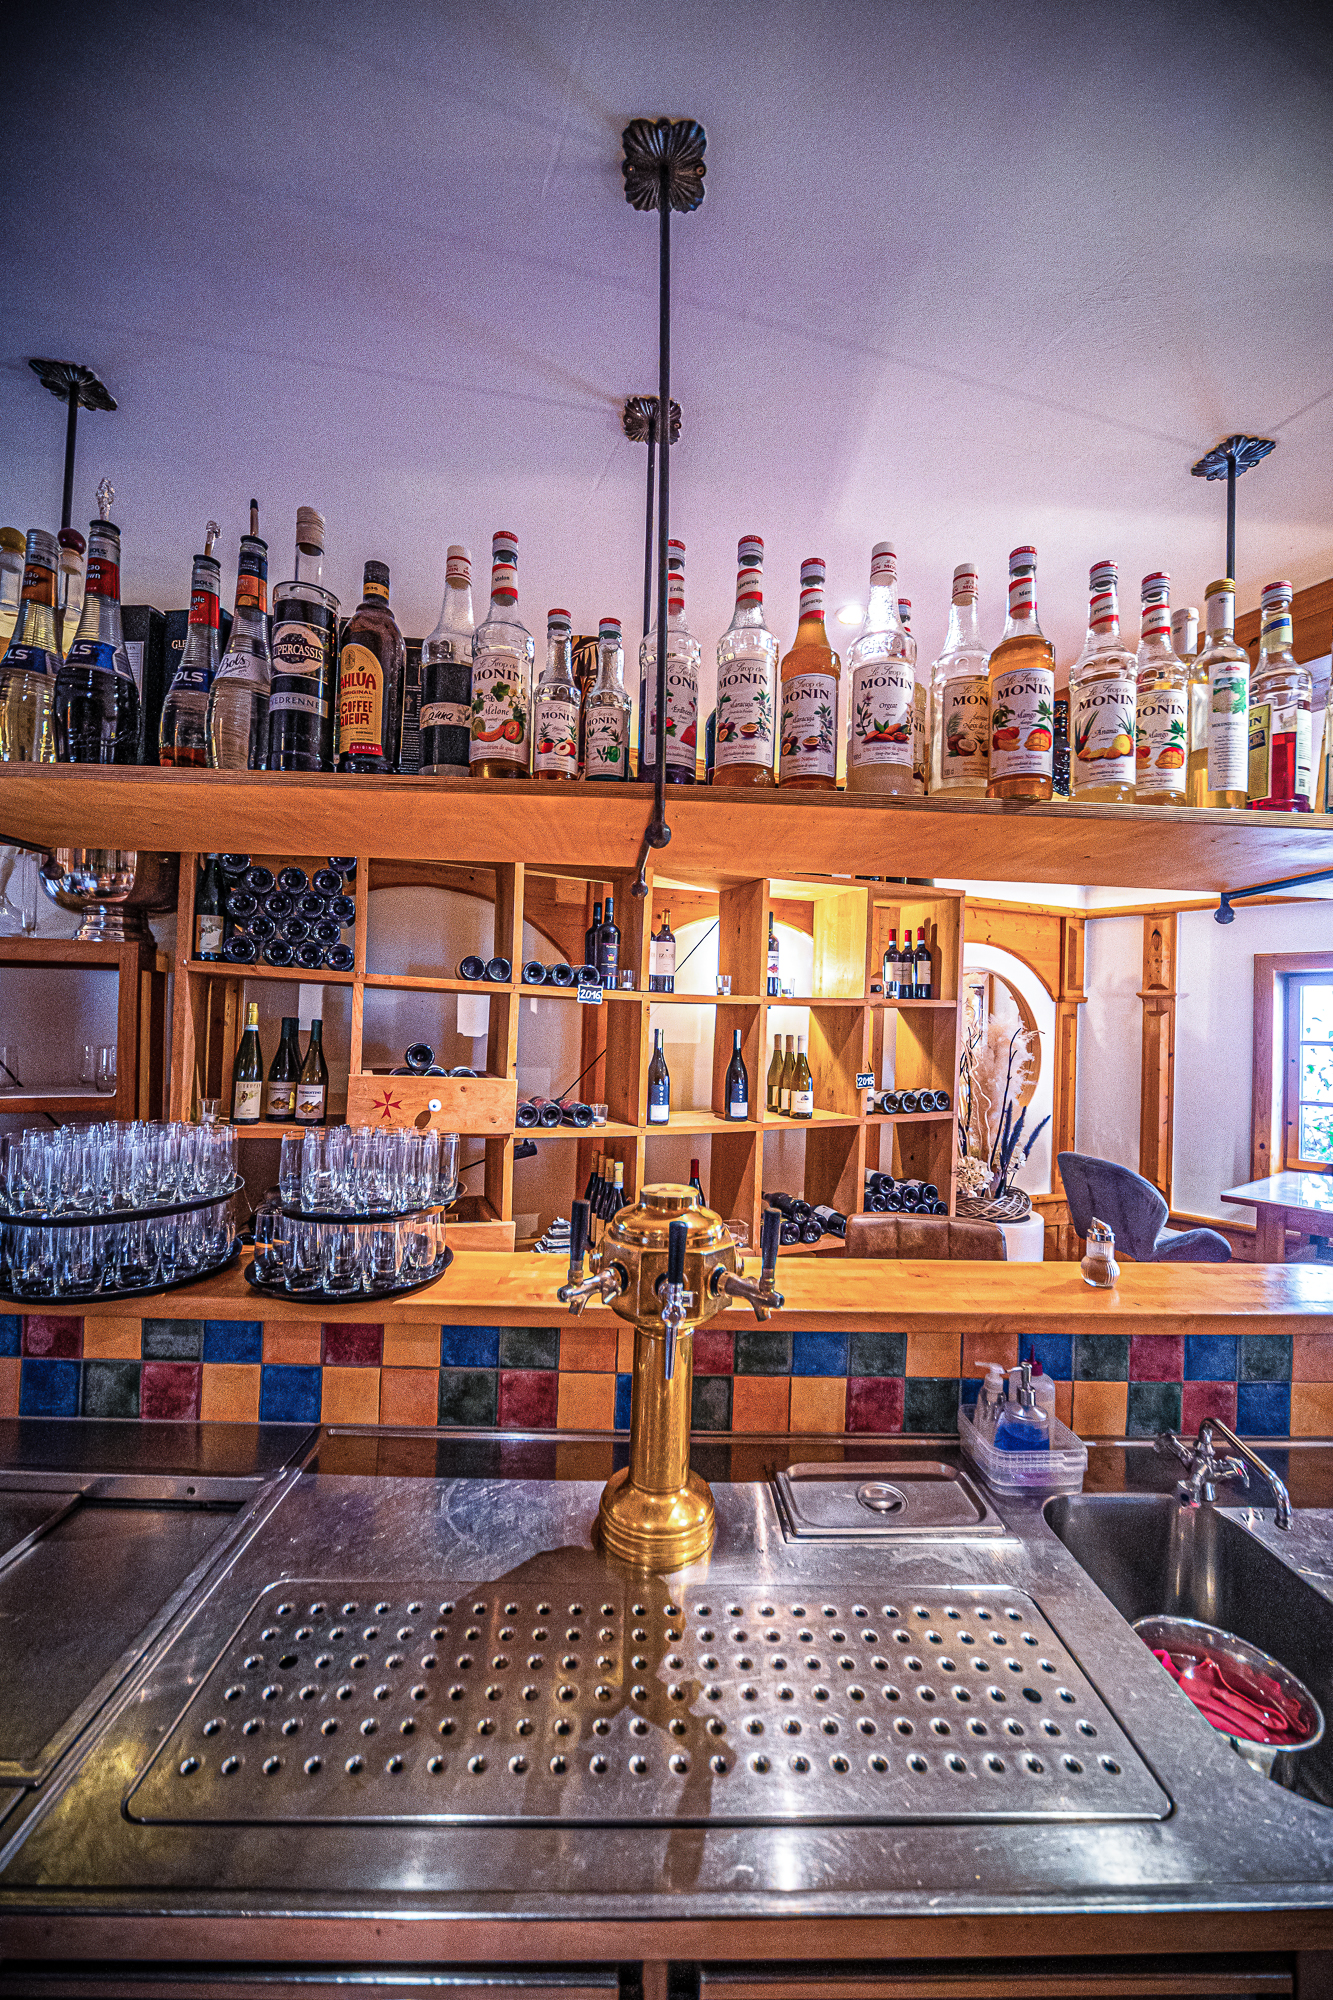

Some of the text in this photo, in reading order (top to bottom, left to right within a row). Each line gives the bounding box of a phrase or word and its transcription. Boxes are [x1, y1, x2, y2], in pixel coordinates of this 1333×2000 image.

[7, 649, 29, 660] LS
[72, 644, 92, 656] LS
[174, 671, 204, 683] OLS
[340, 672, 377, 690] AHLUA
[473, 668, 524, 684] MONIN
[718, 673, 768, 691] MONIN
[861, 676, 913, 691] MONIN
[781, 688, 830, 706] MONIN
[997, 683, 1052, 701] MONIN
[341, 700, 373, 715] COFFEE
[952, 695, 989, 707] MON
[1078, 694, 1134, 711] MONIN
[541, 711, 576, 723] MONIN
[586, 717, 619, 727] MONIN
[352, 744, 379, 752] ORIGINAL
[580, 989, 601, 1000] 2016
